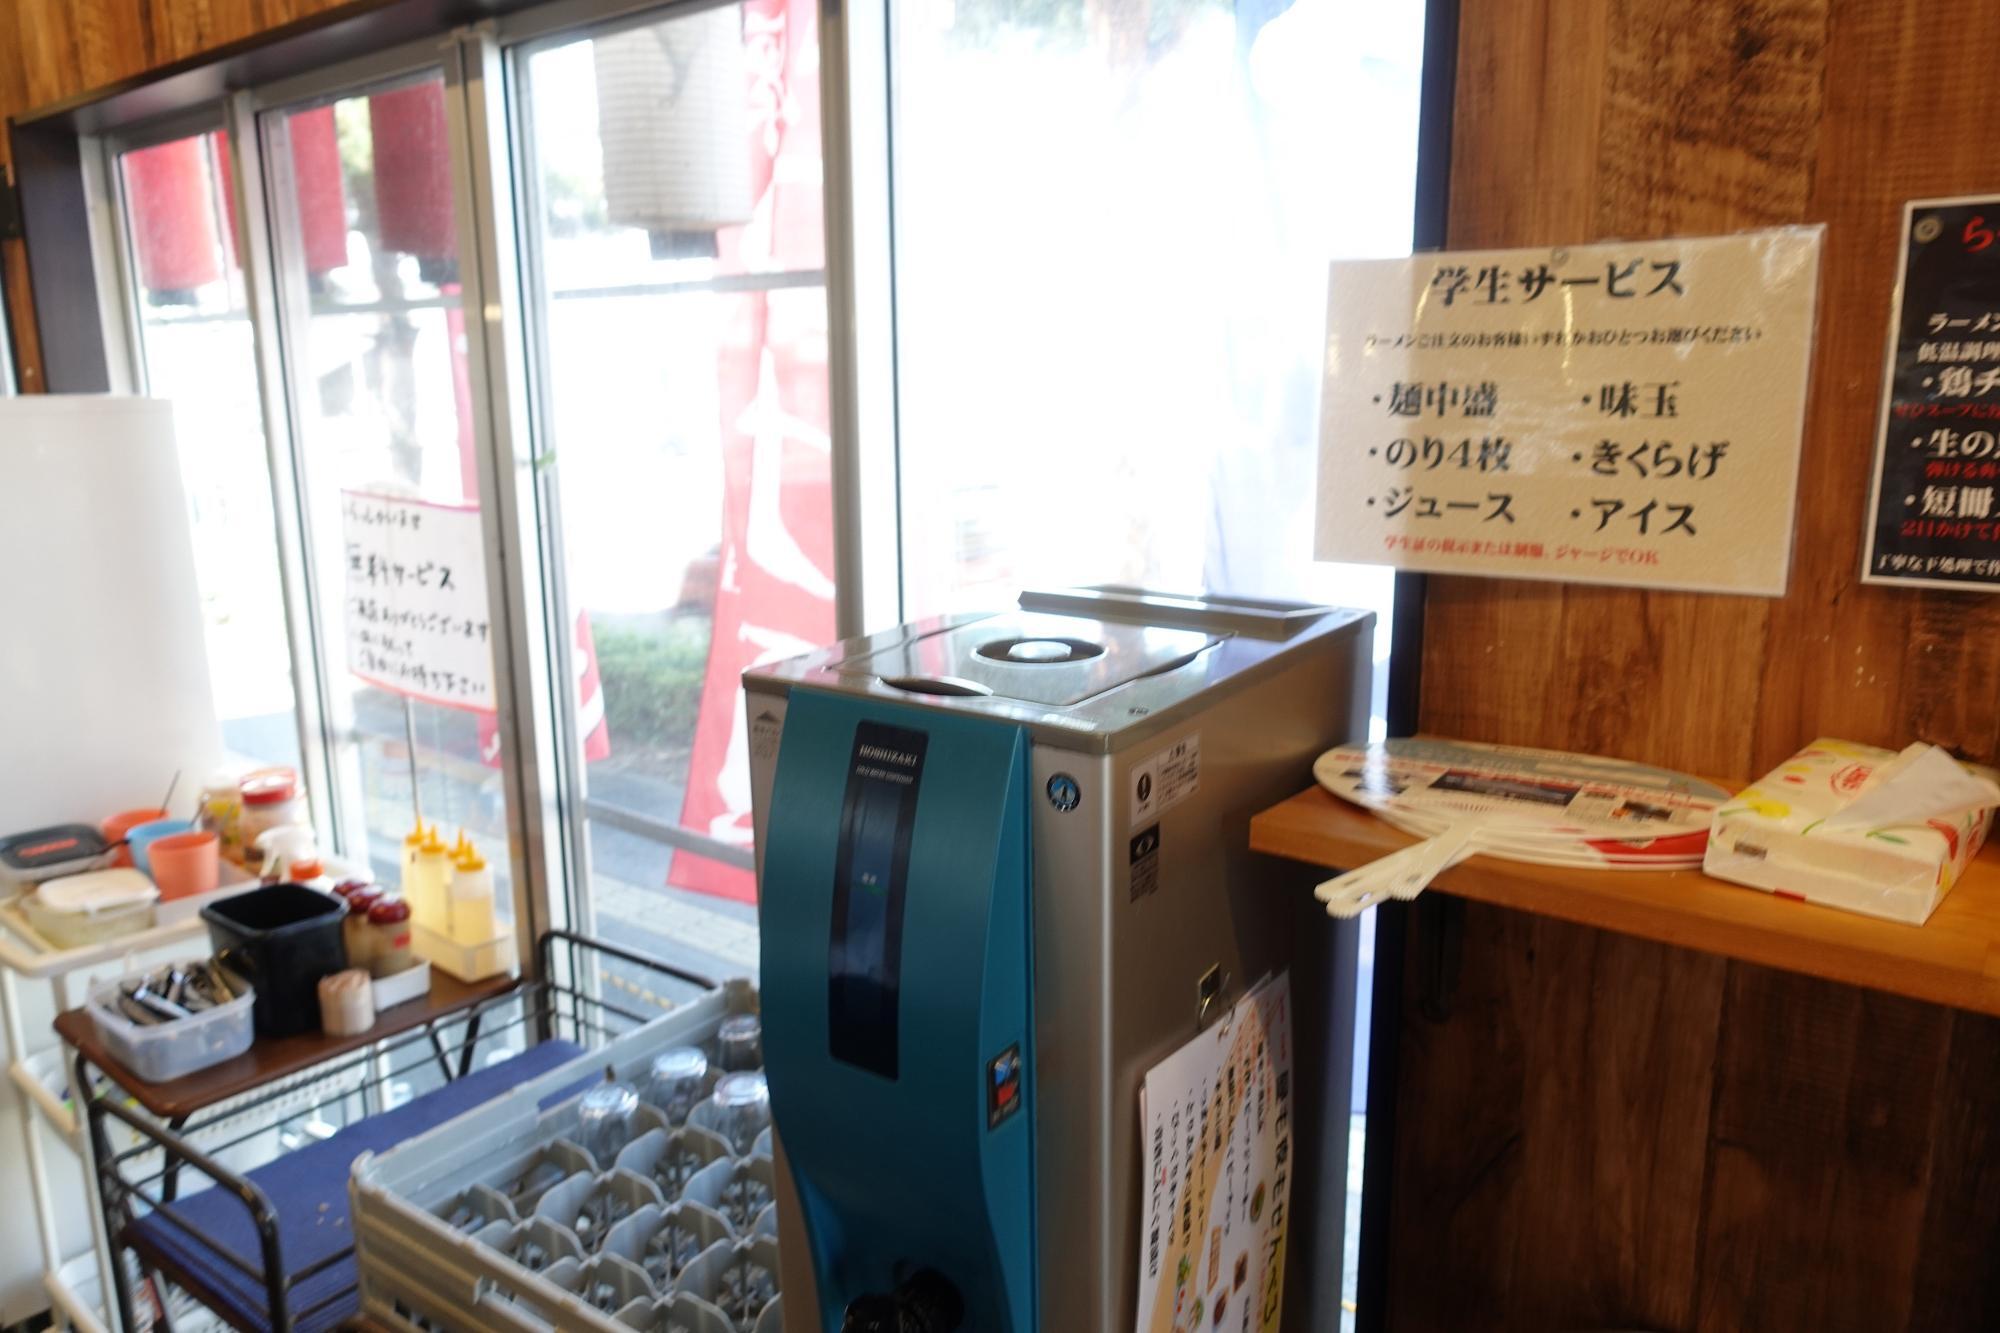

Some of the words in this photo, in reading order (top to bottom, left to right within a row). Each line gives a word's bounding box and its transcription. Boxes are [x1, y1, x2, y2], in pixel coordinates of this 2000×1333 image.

[1432, 258, 1684, 307] 学生サービス
